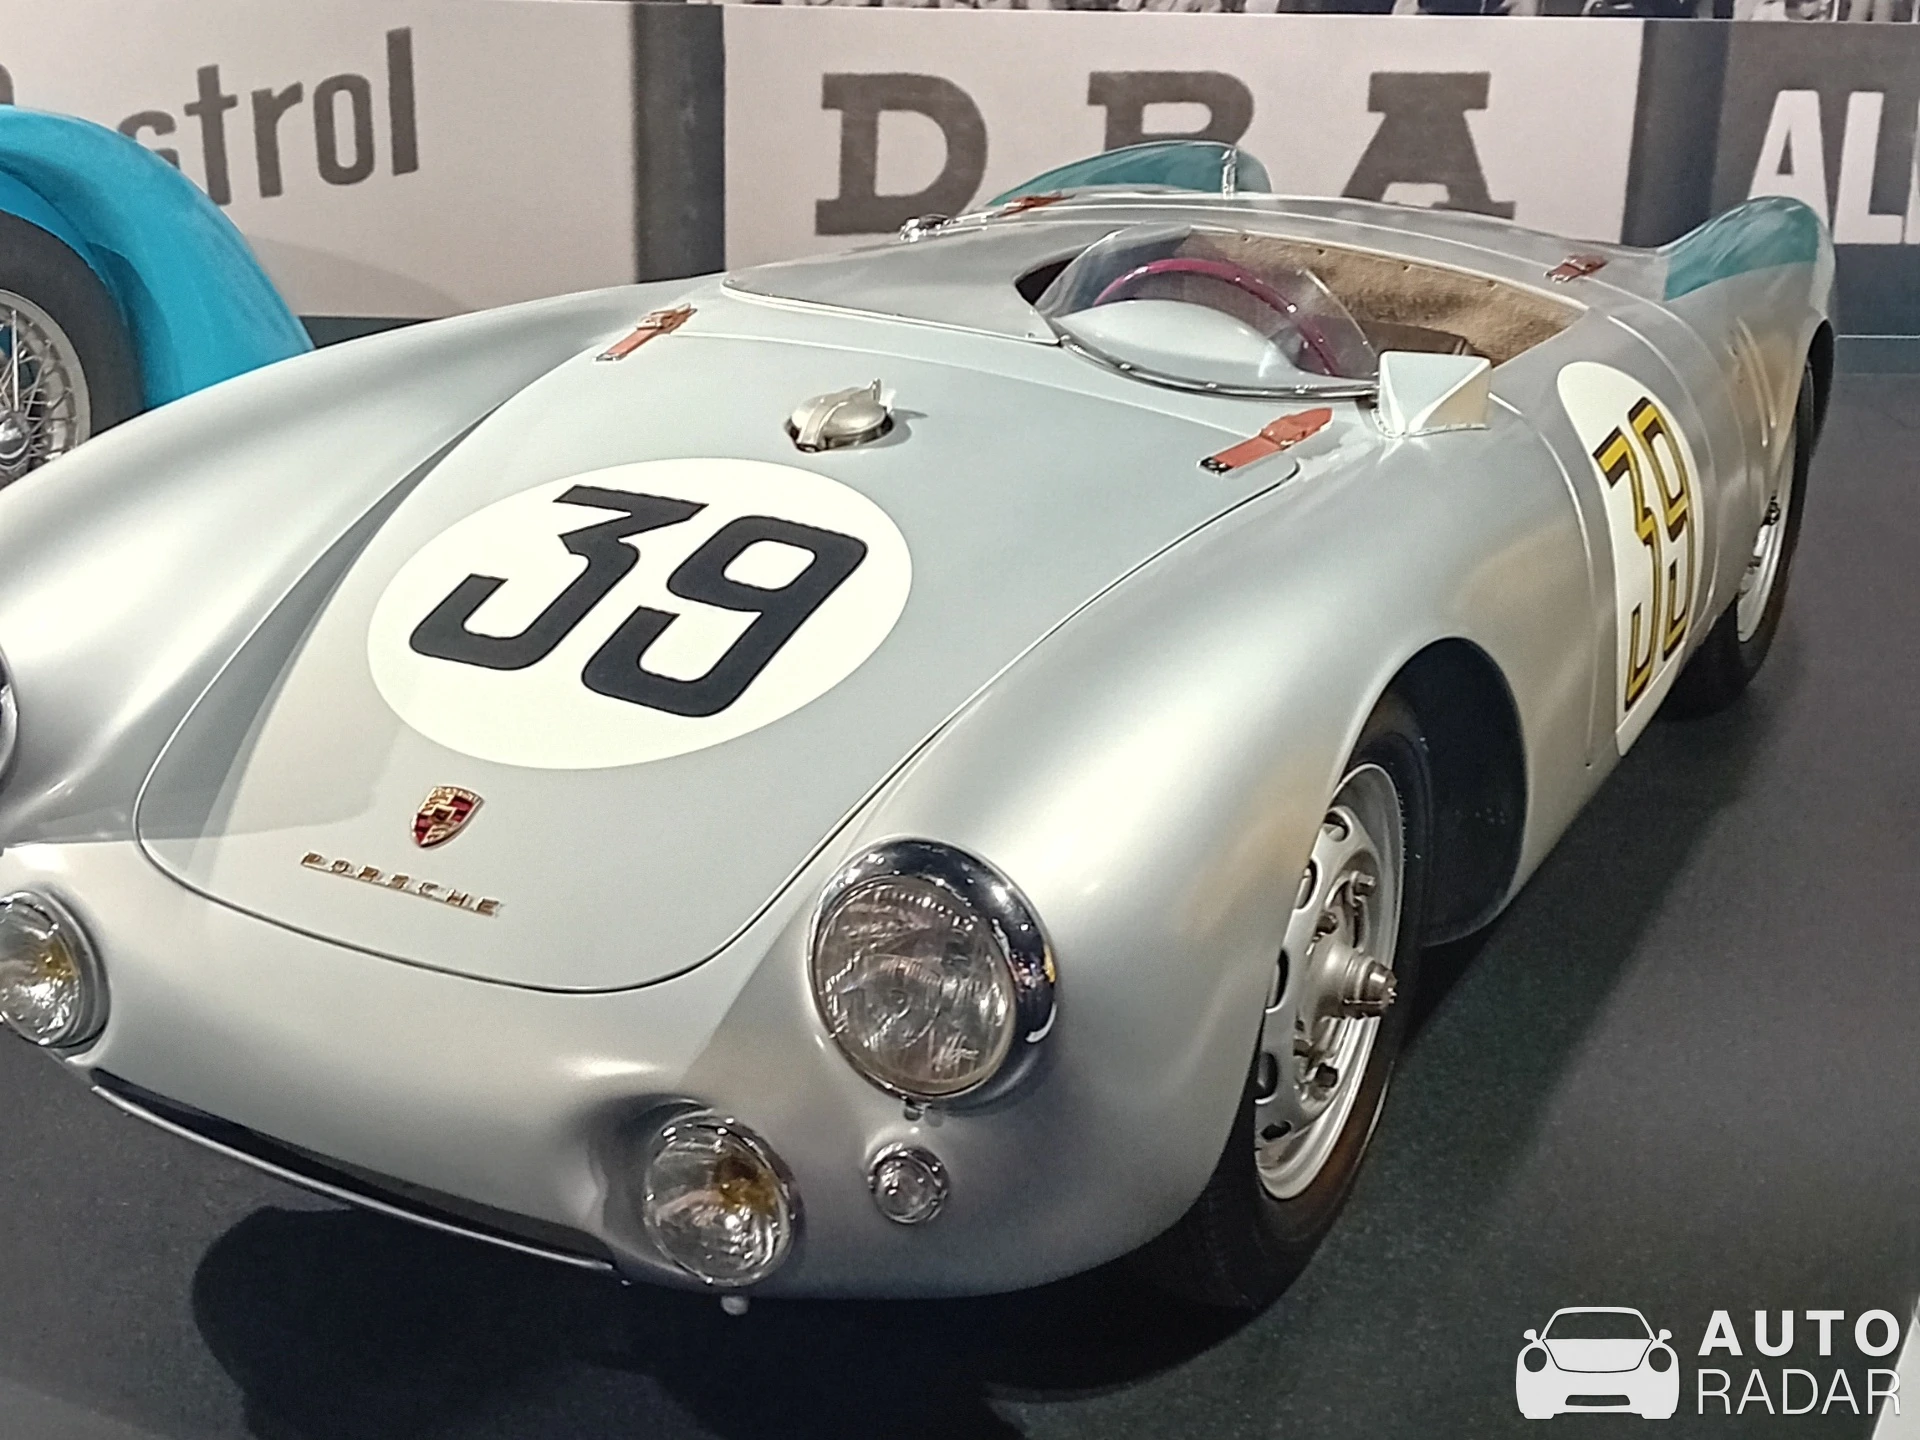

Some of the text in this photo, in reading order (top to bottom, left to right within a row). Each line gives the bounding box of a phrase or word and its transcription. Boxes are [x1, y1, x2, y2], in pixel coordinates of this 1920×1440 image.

[1747, 89, 1920, 244] AL
[409, 484, 868, 718] 39
[1592, 397, 1696, 712] 39
[300, 851, 502, 917] PORSCHE
